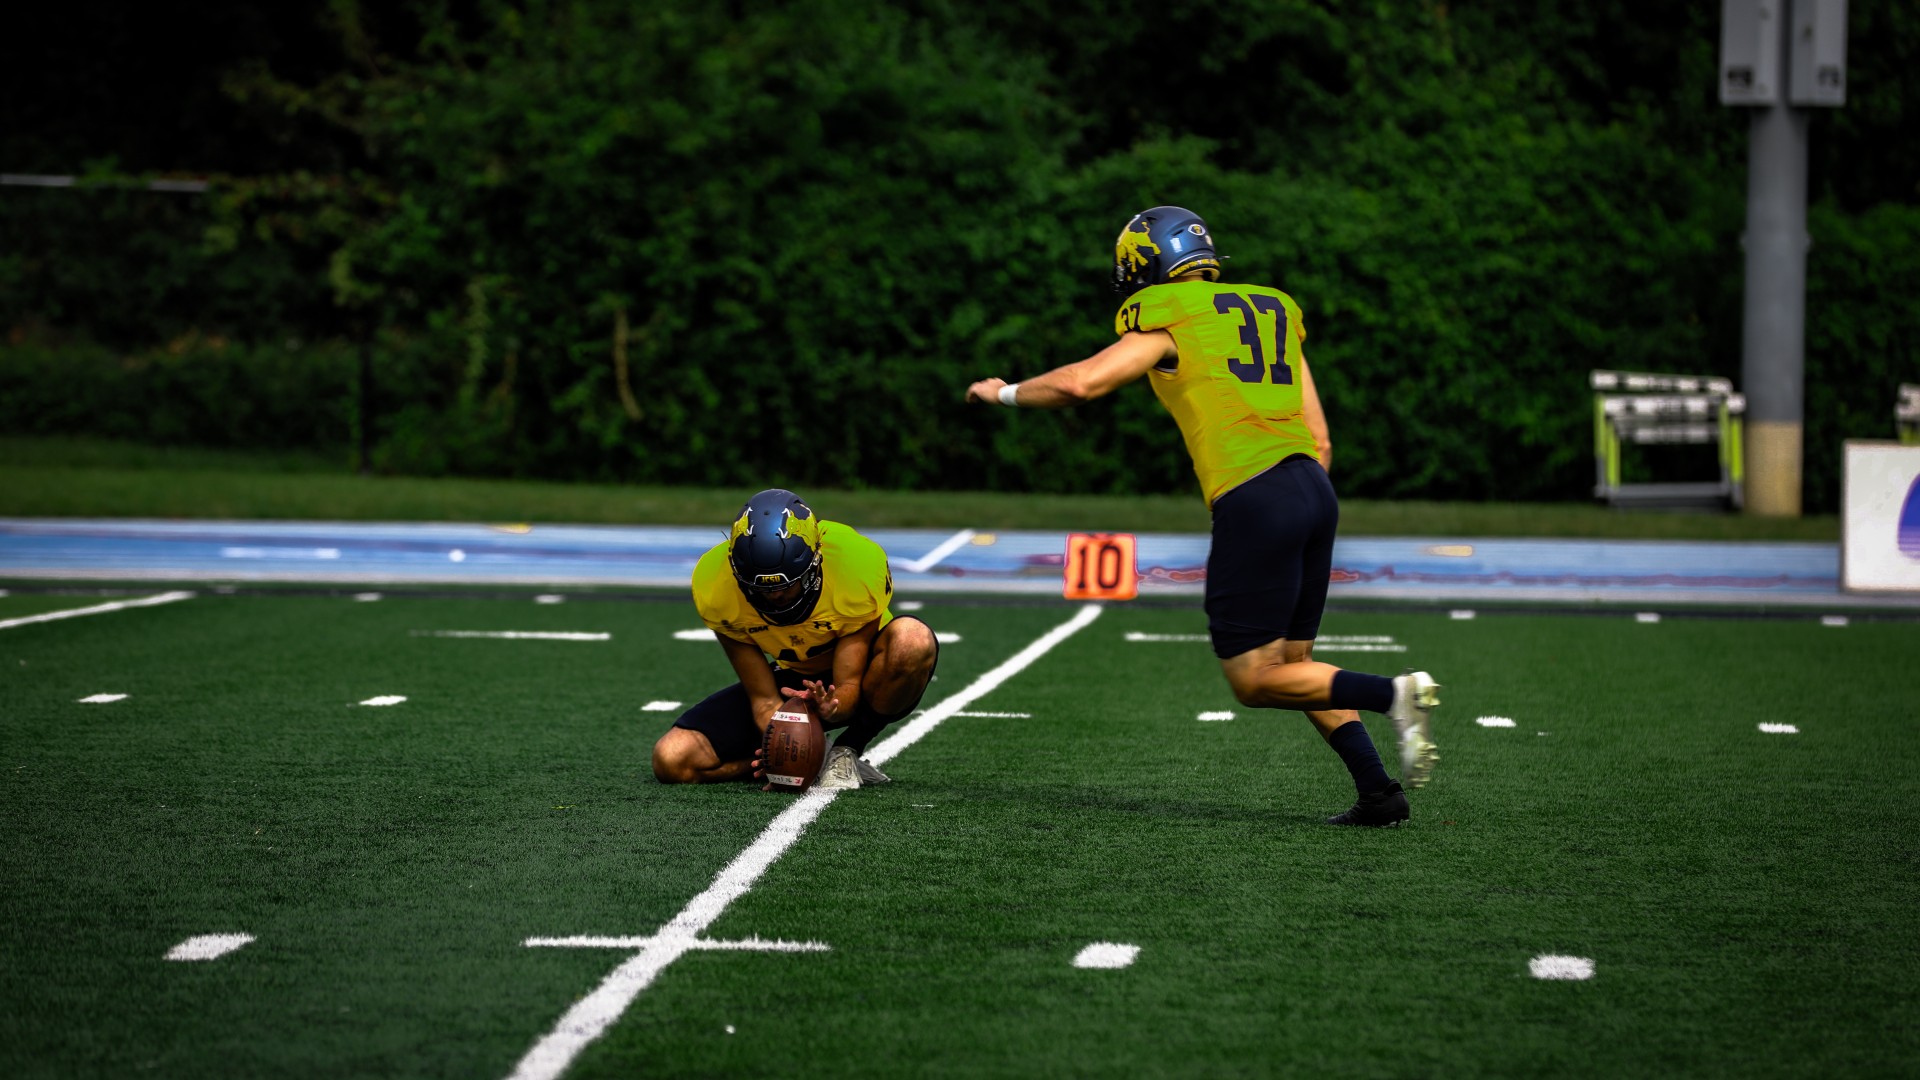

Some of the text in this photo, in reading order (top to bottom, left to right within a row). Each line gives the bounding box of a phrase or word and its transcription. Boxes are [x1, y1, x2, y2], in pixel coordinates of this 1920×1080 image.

[1121, 301, 1142, 333] 37
[1213, 292, 1293, 385] 37
[761, 575, 782, 584] JCSU
[1076, 545, 1122, 590] 10
[748, 625, 769, 634] CIAA
[790, 737, 800, 762] GST
